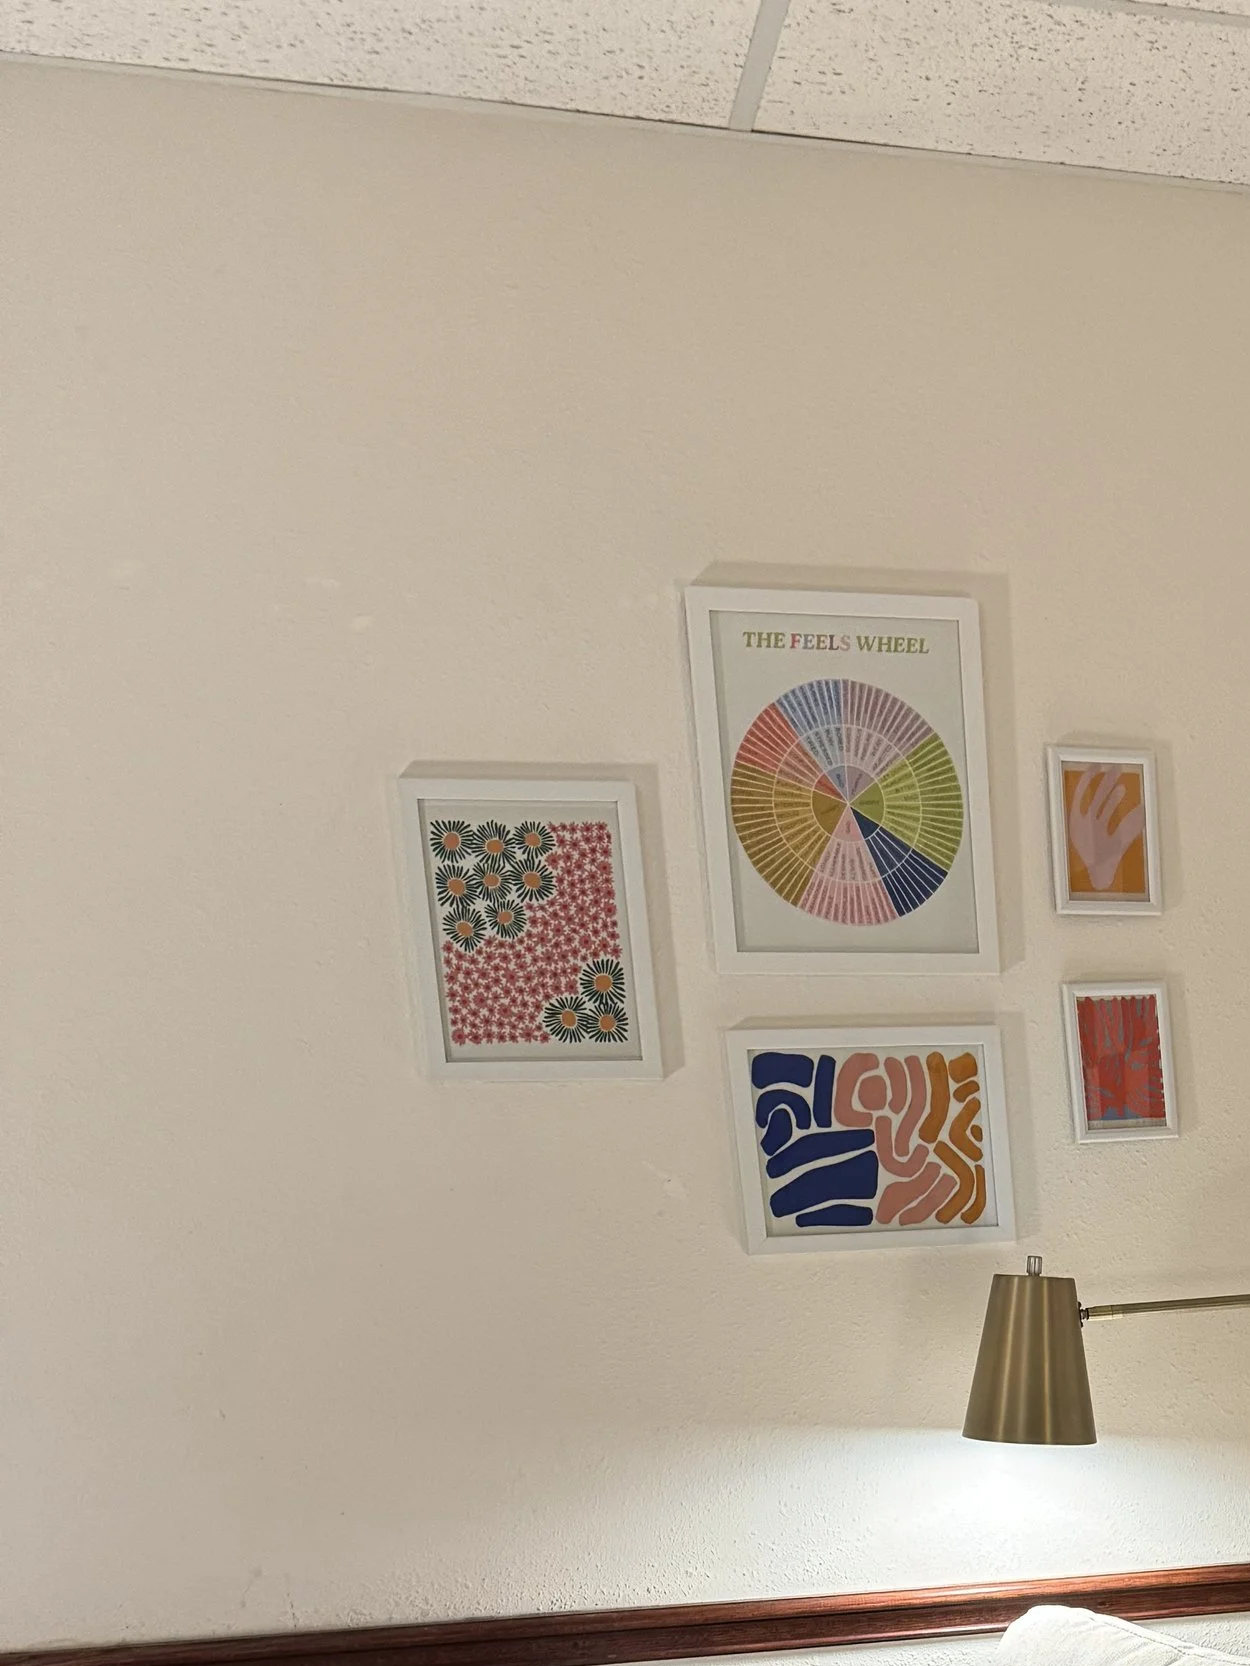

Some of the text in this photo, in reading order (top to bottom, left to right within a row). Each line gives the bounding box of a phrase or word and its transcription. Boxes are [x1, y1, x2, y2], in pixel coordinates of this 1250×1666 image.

[743, 632, 929, 654] THE FEELS WHEEL
